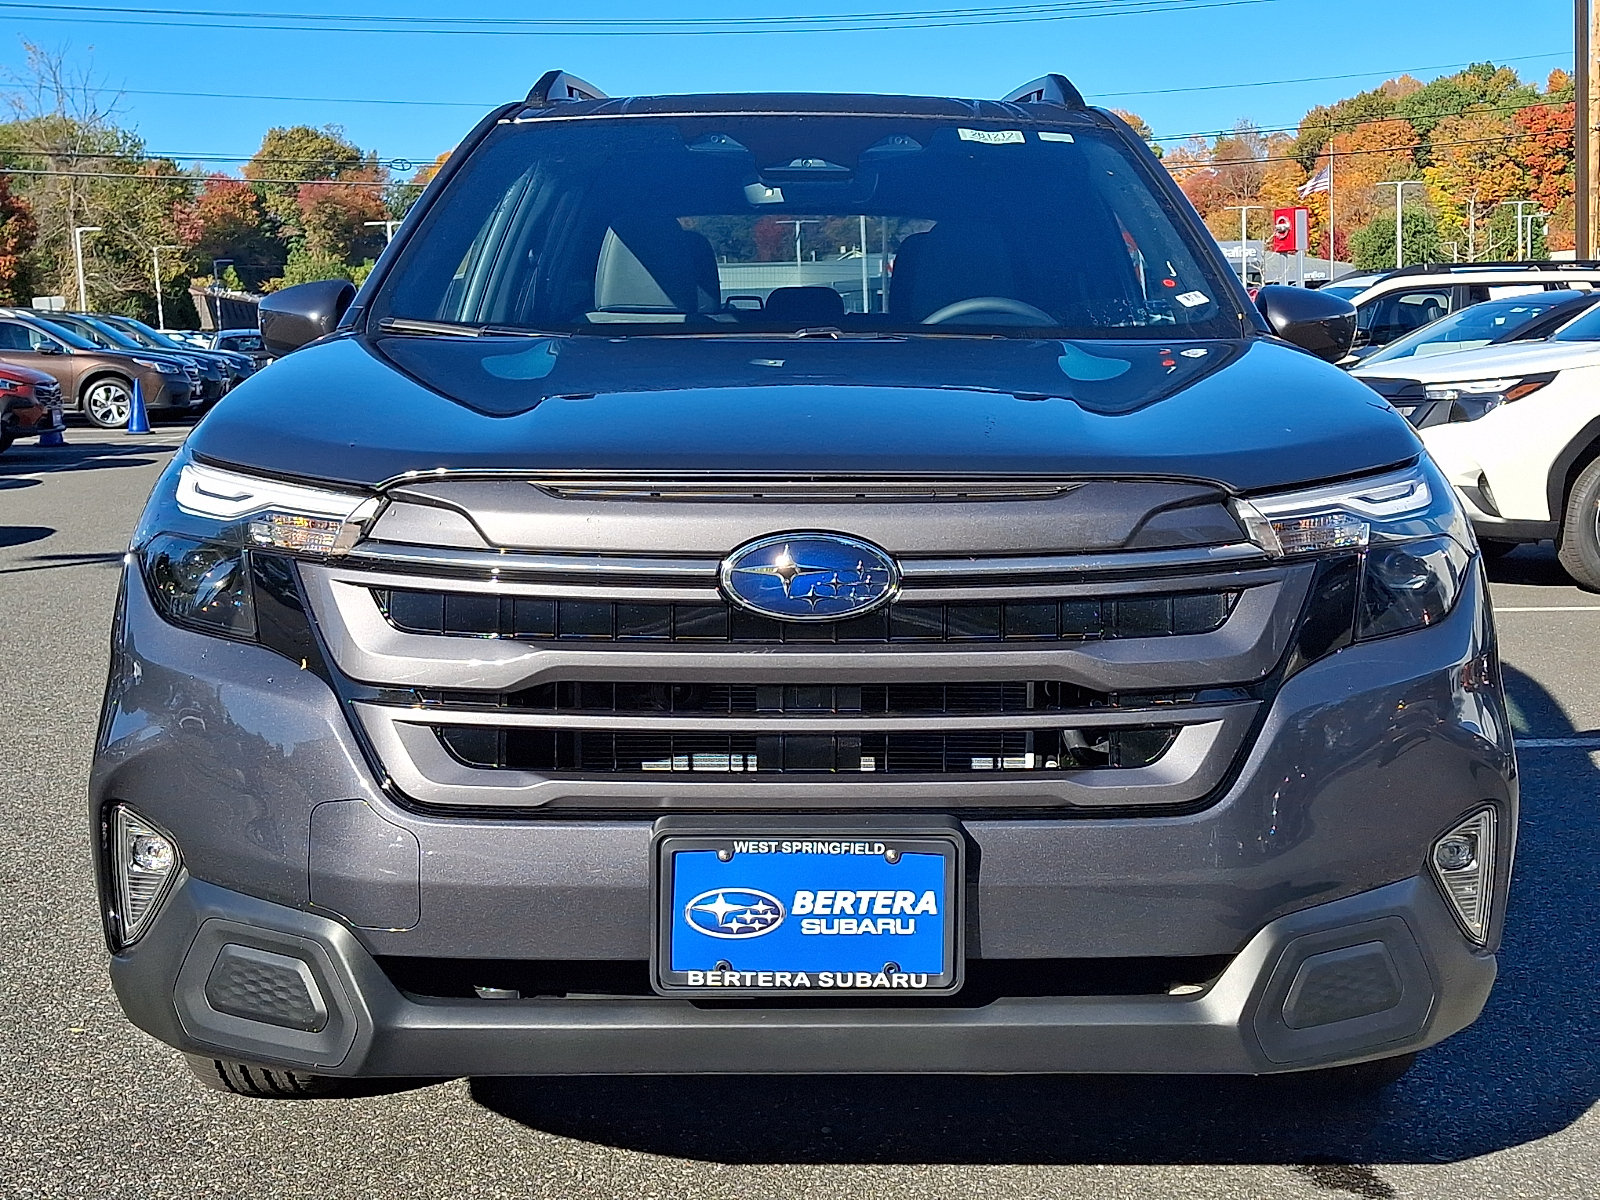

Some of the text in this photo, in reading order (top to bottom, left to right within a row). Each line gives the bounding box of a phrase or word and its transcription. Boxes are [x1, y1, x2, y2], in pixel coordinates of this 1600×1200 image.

[733, 841, 886, 855] WEST SPRINGFIELD
[791, 890, 937, 915] BERTERA
[800, 918, 915, 935] SUBARU
[687, 971, 928, 988] BERTERA SUBARU
